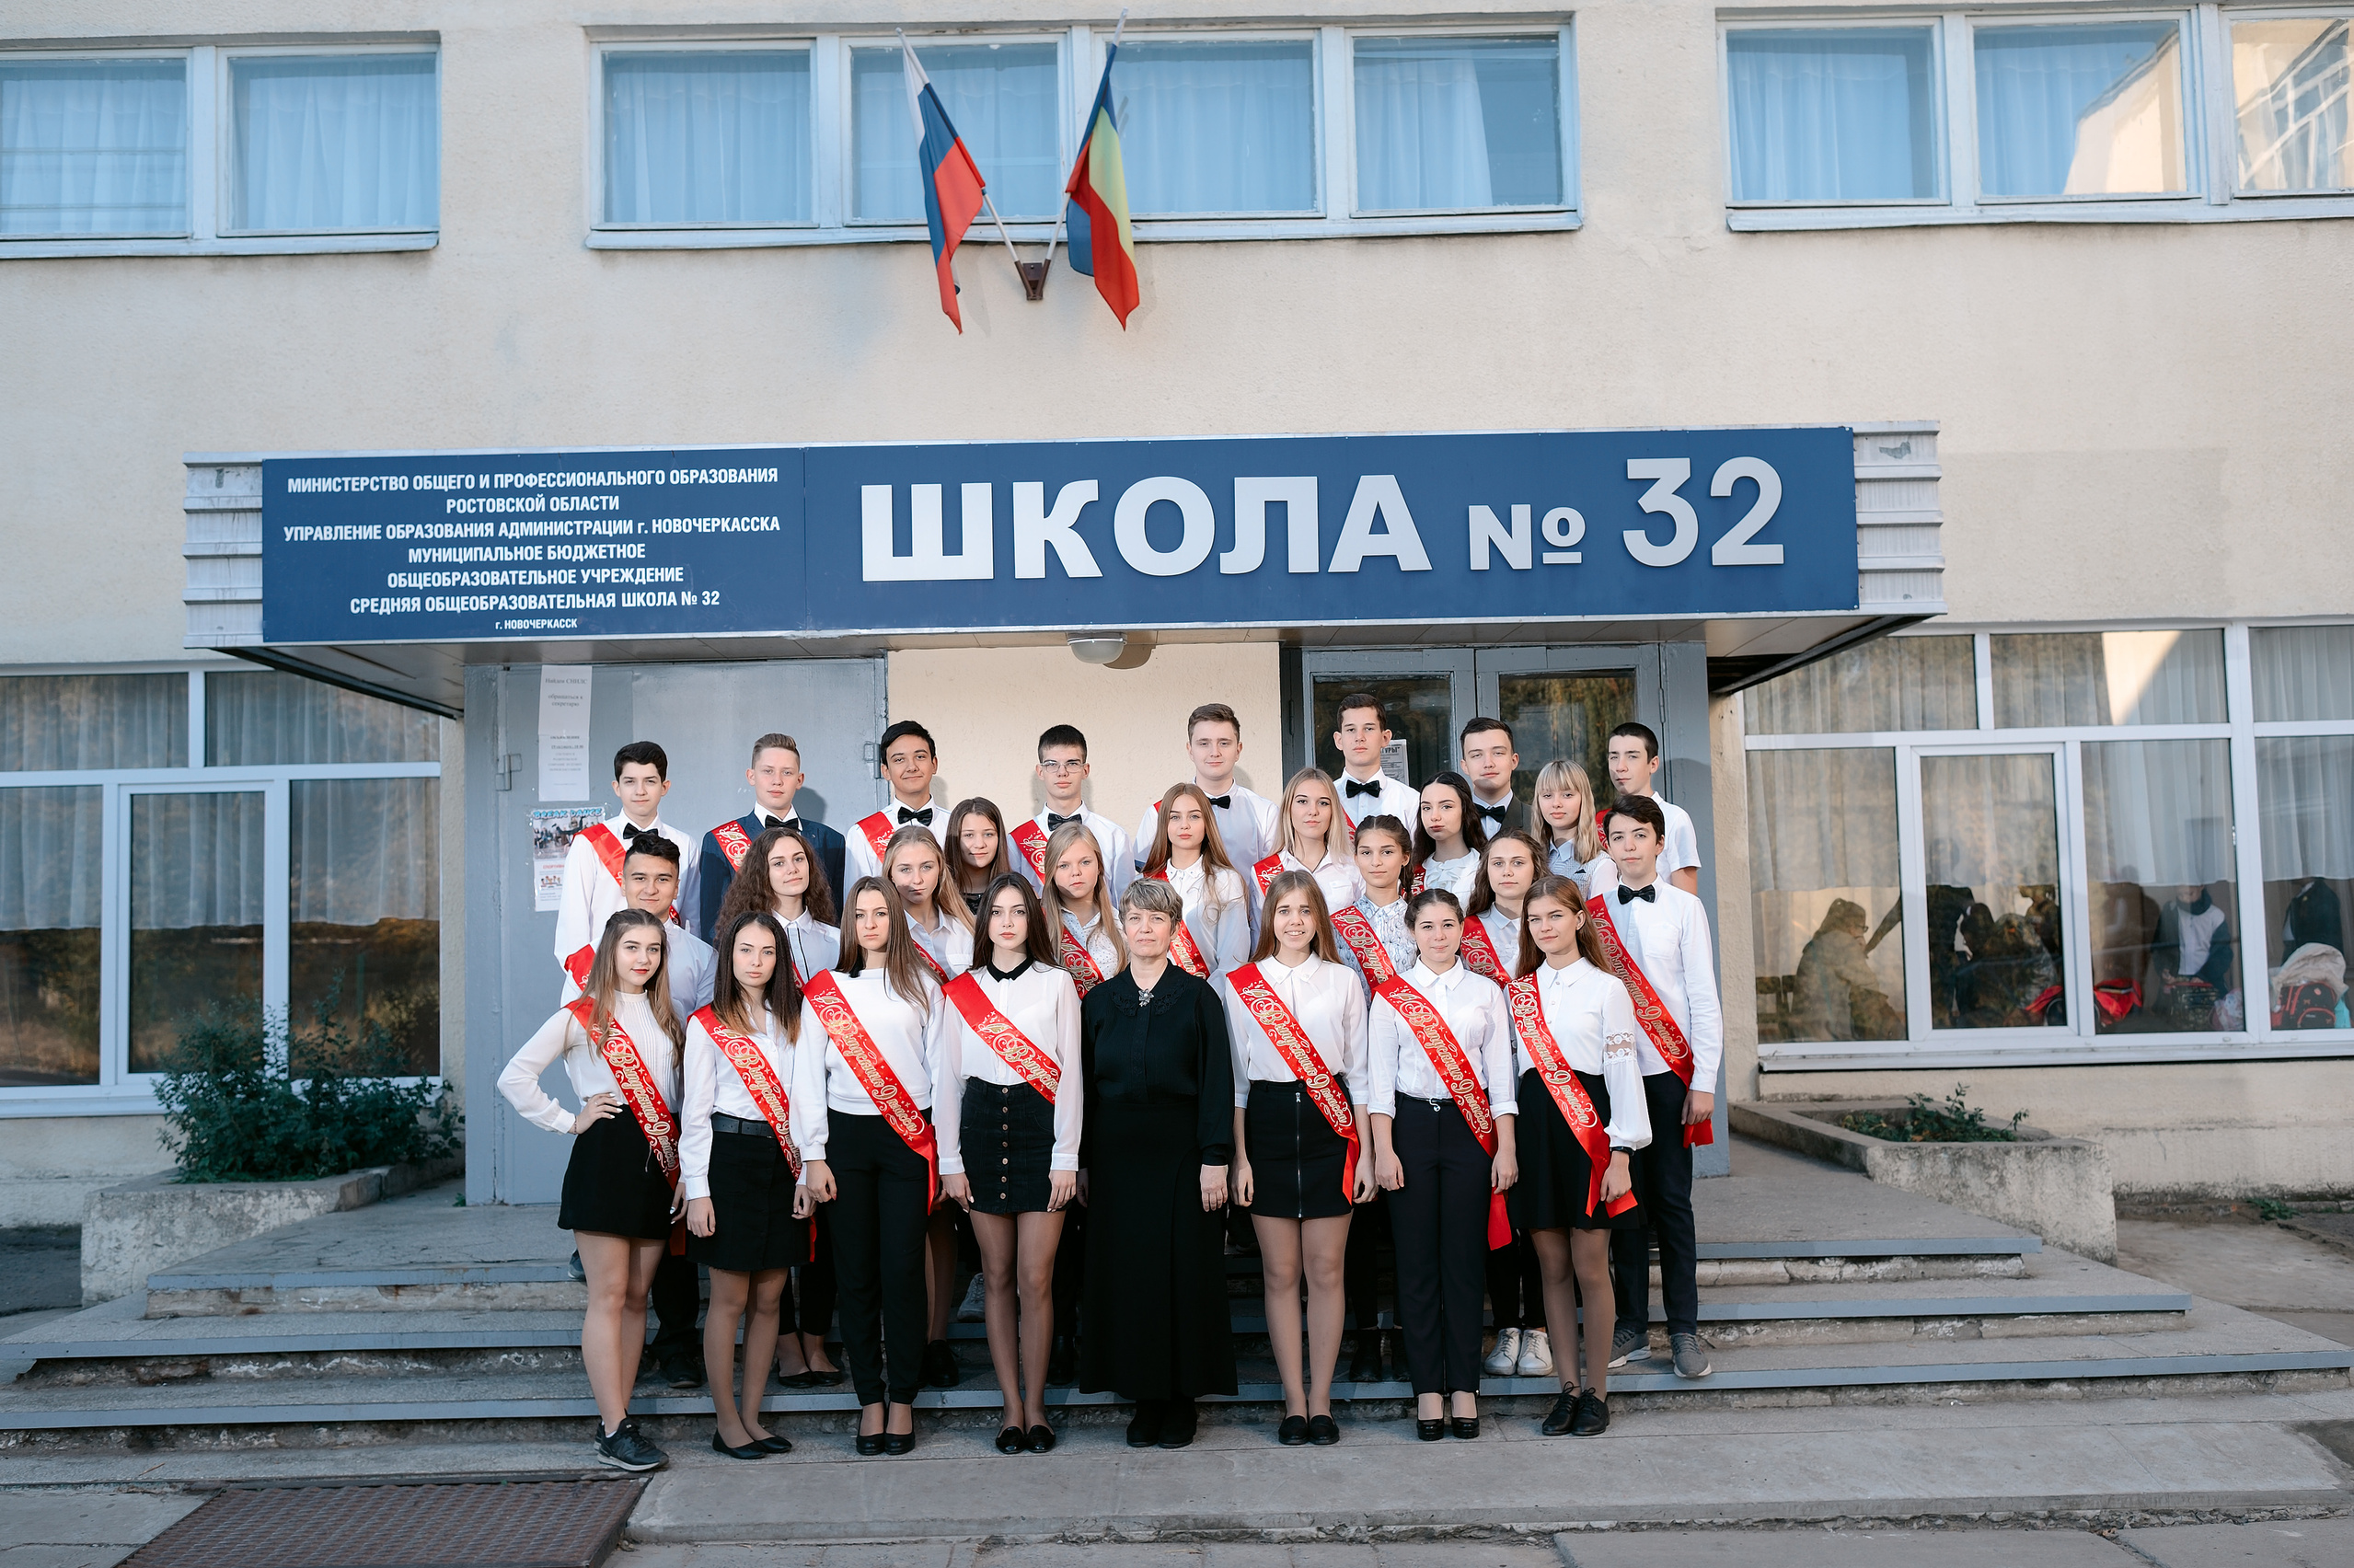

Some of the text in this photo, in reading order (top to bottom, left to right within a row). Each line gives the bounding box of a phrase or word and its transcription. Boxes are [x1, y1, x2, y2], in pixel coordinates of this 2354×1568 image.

[287, 467, 779, 493] МИНИСТЕРСТВО ОБЩЕГО И ПРОФЕССИОНАЛЬНОГО ОБРАЗОВАНИЯ
[446, 493, 619, 514] РОСТОВСКОЙ ОБЛАСТИ
[860, 456, 1784, 582] ШКОЛА № 32
[283, 515, 780, 542] УПРАВЛЕНИЕ ОБРАЗОВАНИЯ АДМИНИСТРАЦИИ г. НОВОЧЕРКАССКА
[408, 543, 646, 564] МУНИЦИПАЛЬНОЕ БЮДЖЕТНОЕ
[387, 566, 684, 590] ОБЩЕОБРАЗОВАТЕЛЬНОЕ УЧРЕЖДЕНИЕ
[350, 590, 721, 616] СРЕДНЯЯ ОБЩЕОБРАЗОВАТЕЛЬНАЯ ШКОЛА № 32
[504, 617, 578, 630] НОВОЧЕРКАССК
[533, 808, 603, 820] BREAK DANCE
[1636, 1006, 1662, 1020] 9
[1651, 1020, 1680, 1056] класса
[819, 1004, 917, 1133] Выпускник 9 класса
[1251, 997, 1347, 1124] Выпускник 9 класса
[1400, 1000, 1489, 1130] Выпускник 9 класса
[1511, 993, 1590, 1124] Выпускник 9 класса
[725, 1039, 787, 1122] Выпускник
[602, 1037, 676, 1168] Выпускник 9 класса
